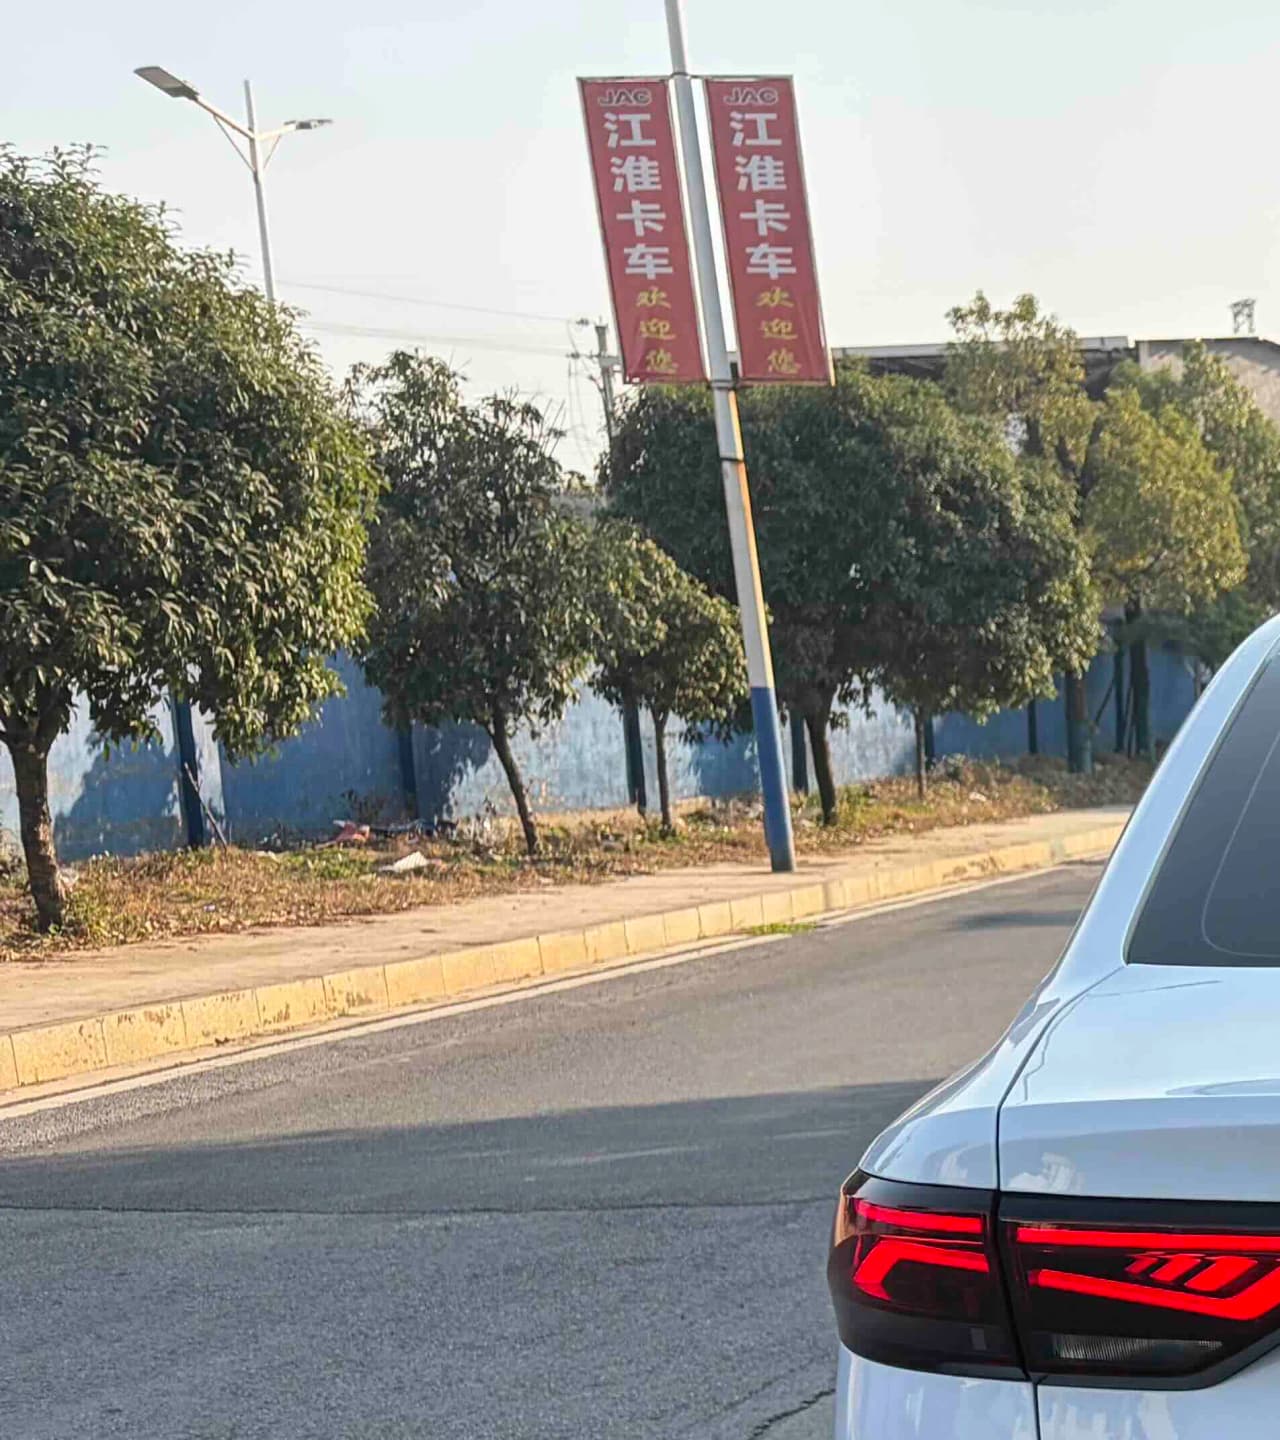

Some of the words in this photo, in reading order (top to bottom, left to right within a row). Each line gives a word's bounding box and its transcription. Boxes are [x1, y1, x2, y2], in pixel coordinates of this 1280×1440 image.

[598, 88, 652, 106] JAC
[723, 87, 779, 106] JAC
[603, 112, 673, 280] 江淮卡车
[729, 111, 797, 280] 江淮卡车
